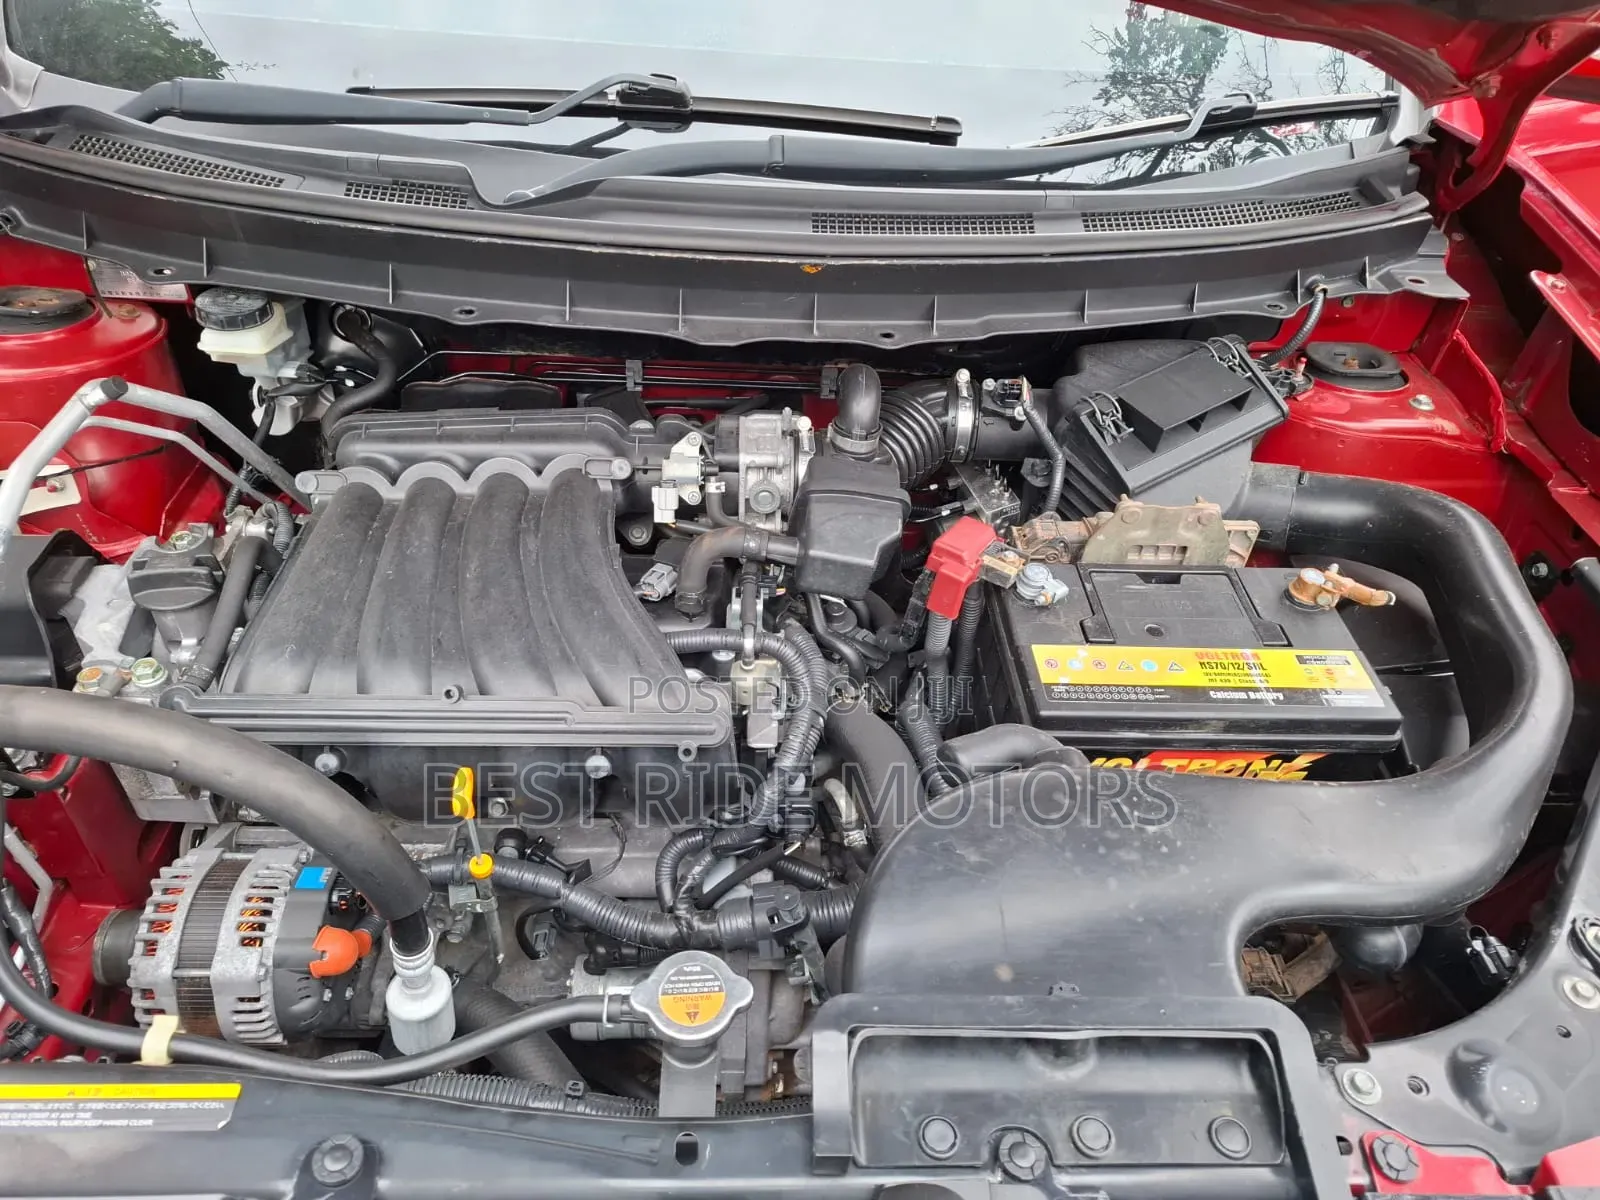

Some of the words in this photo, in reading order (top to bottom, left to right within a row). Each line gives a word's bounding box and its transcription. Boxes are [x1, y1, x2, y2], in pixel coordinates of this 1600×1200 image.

[1195, 652, 1261, 661] VOLTRON
[1209, 690, 1248, 699] Calcium
[1248, 691, 1284, 700] Battery
